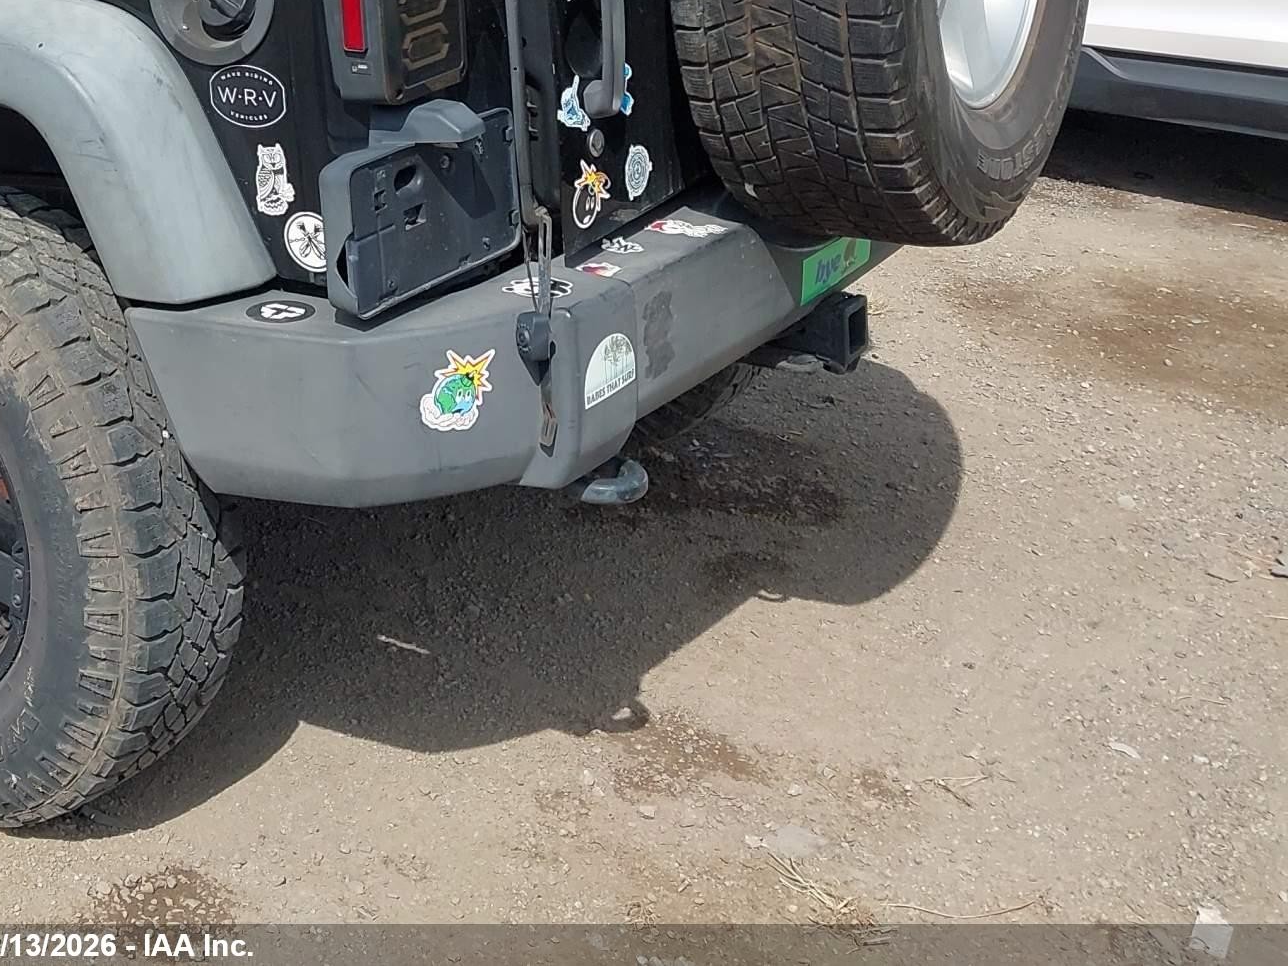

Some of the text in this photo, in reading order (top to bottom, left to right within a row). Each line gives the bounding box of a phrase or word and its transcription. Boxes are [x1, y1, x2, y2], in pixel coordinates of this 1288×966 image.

[586, 368, 635, 406] BABES THAT SURF
